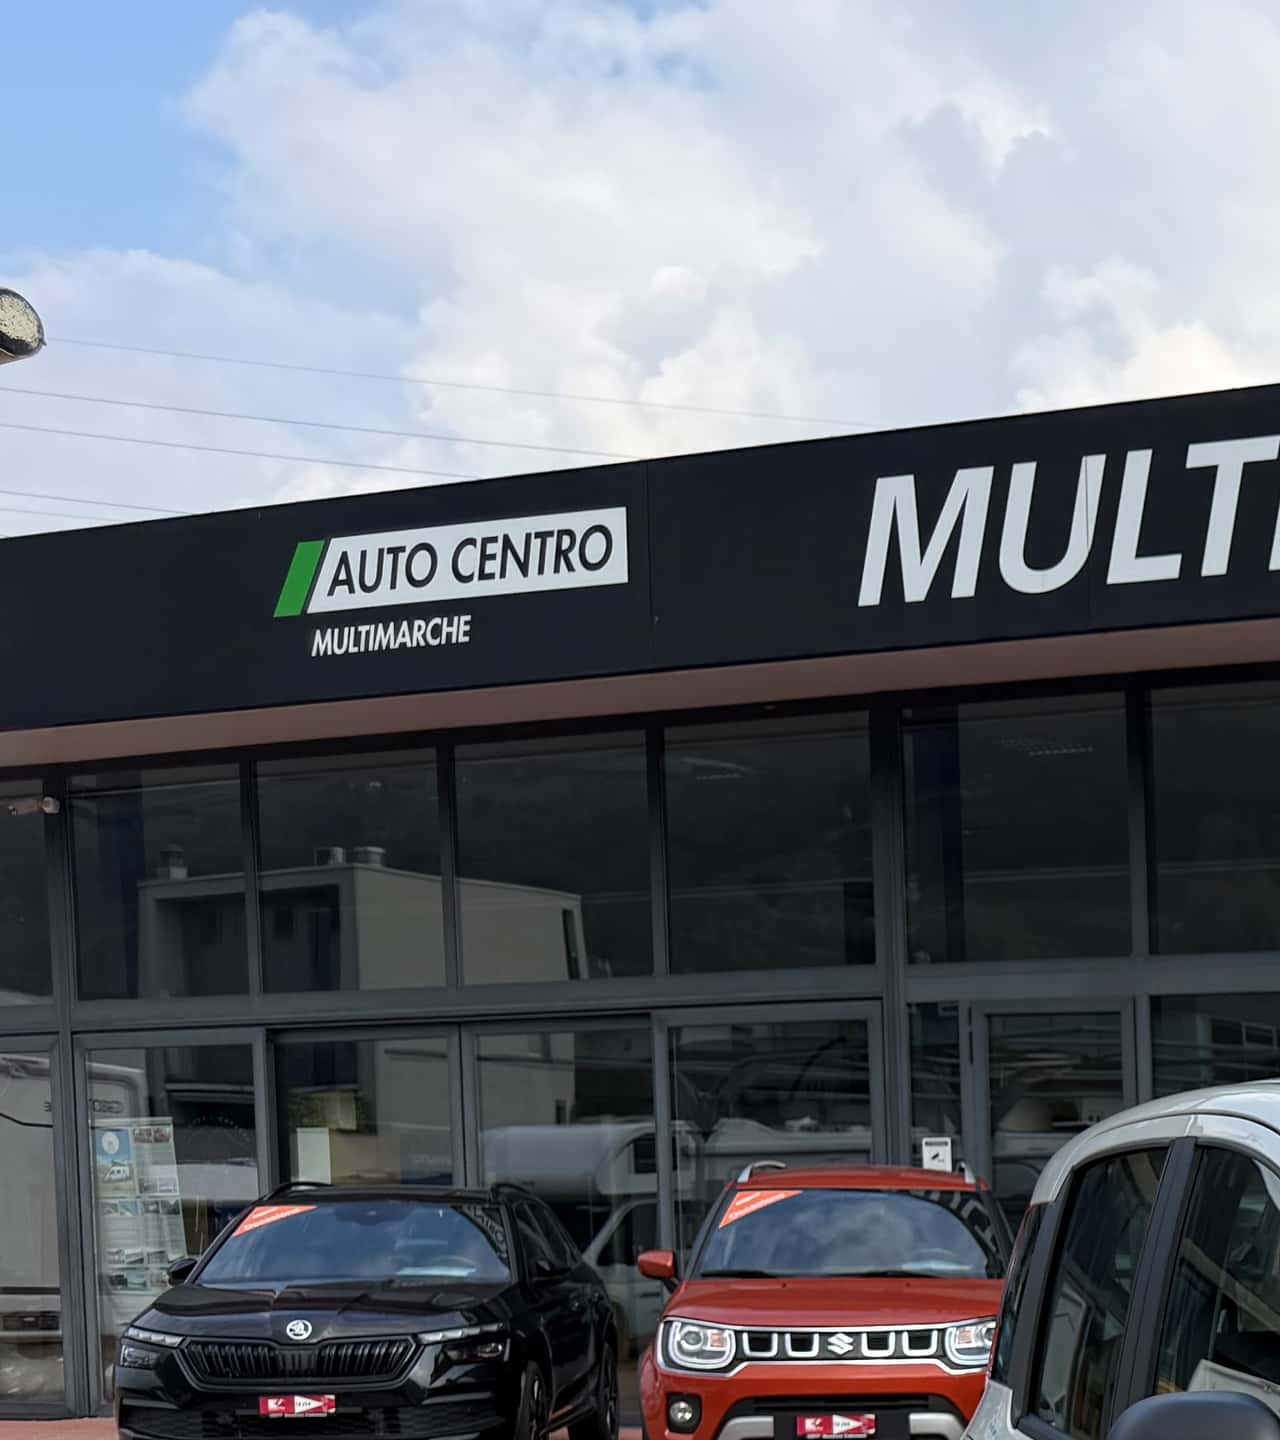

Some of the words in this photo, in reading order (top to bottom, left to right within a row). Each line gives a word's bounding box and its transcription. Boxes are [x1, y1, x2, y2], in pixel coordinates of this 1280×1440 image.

[327, 542, 438, 598] AUTO
[451, 524, 613, 585] CENTRO
[311, 614, 472, 657] MULTIMARCHE
